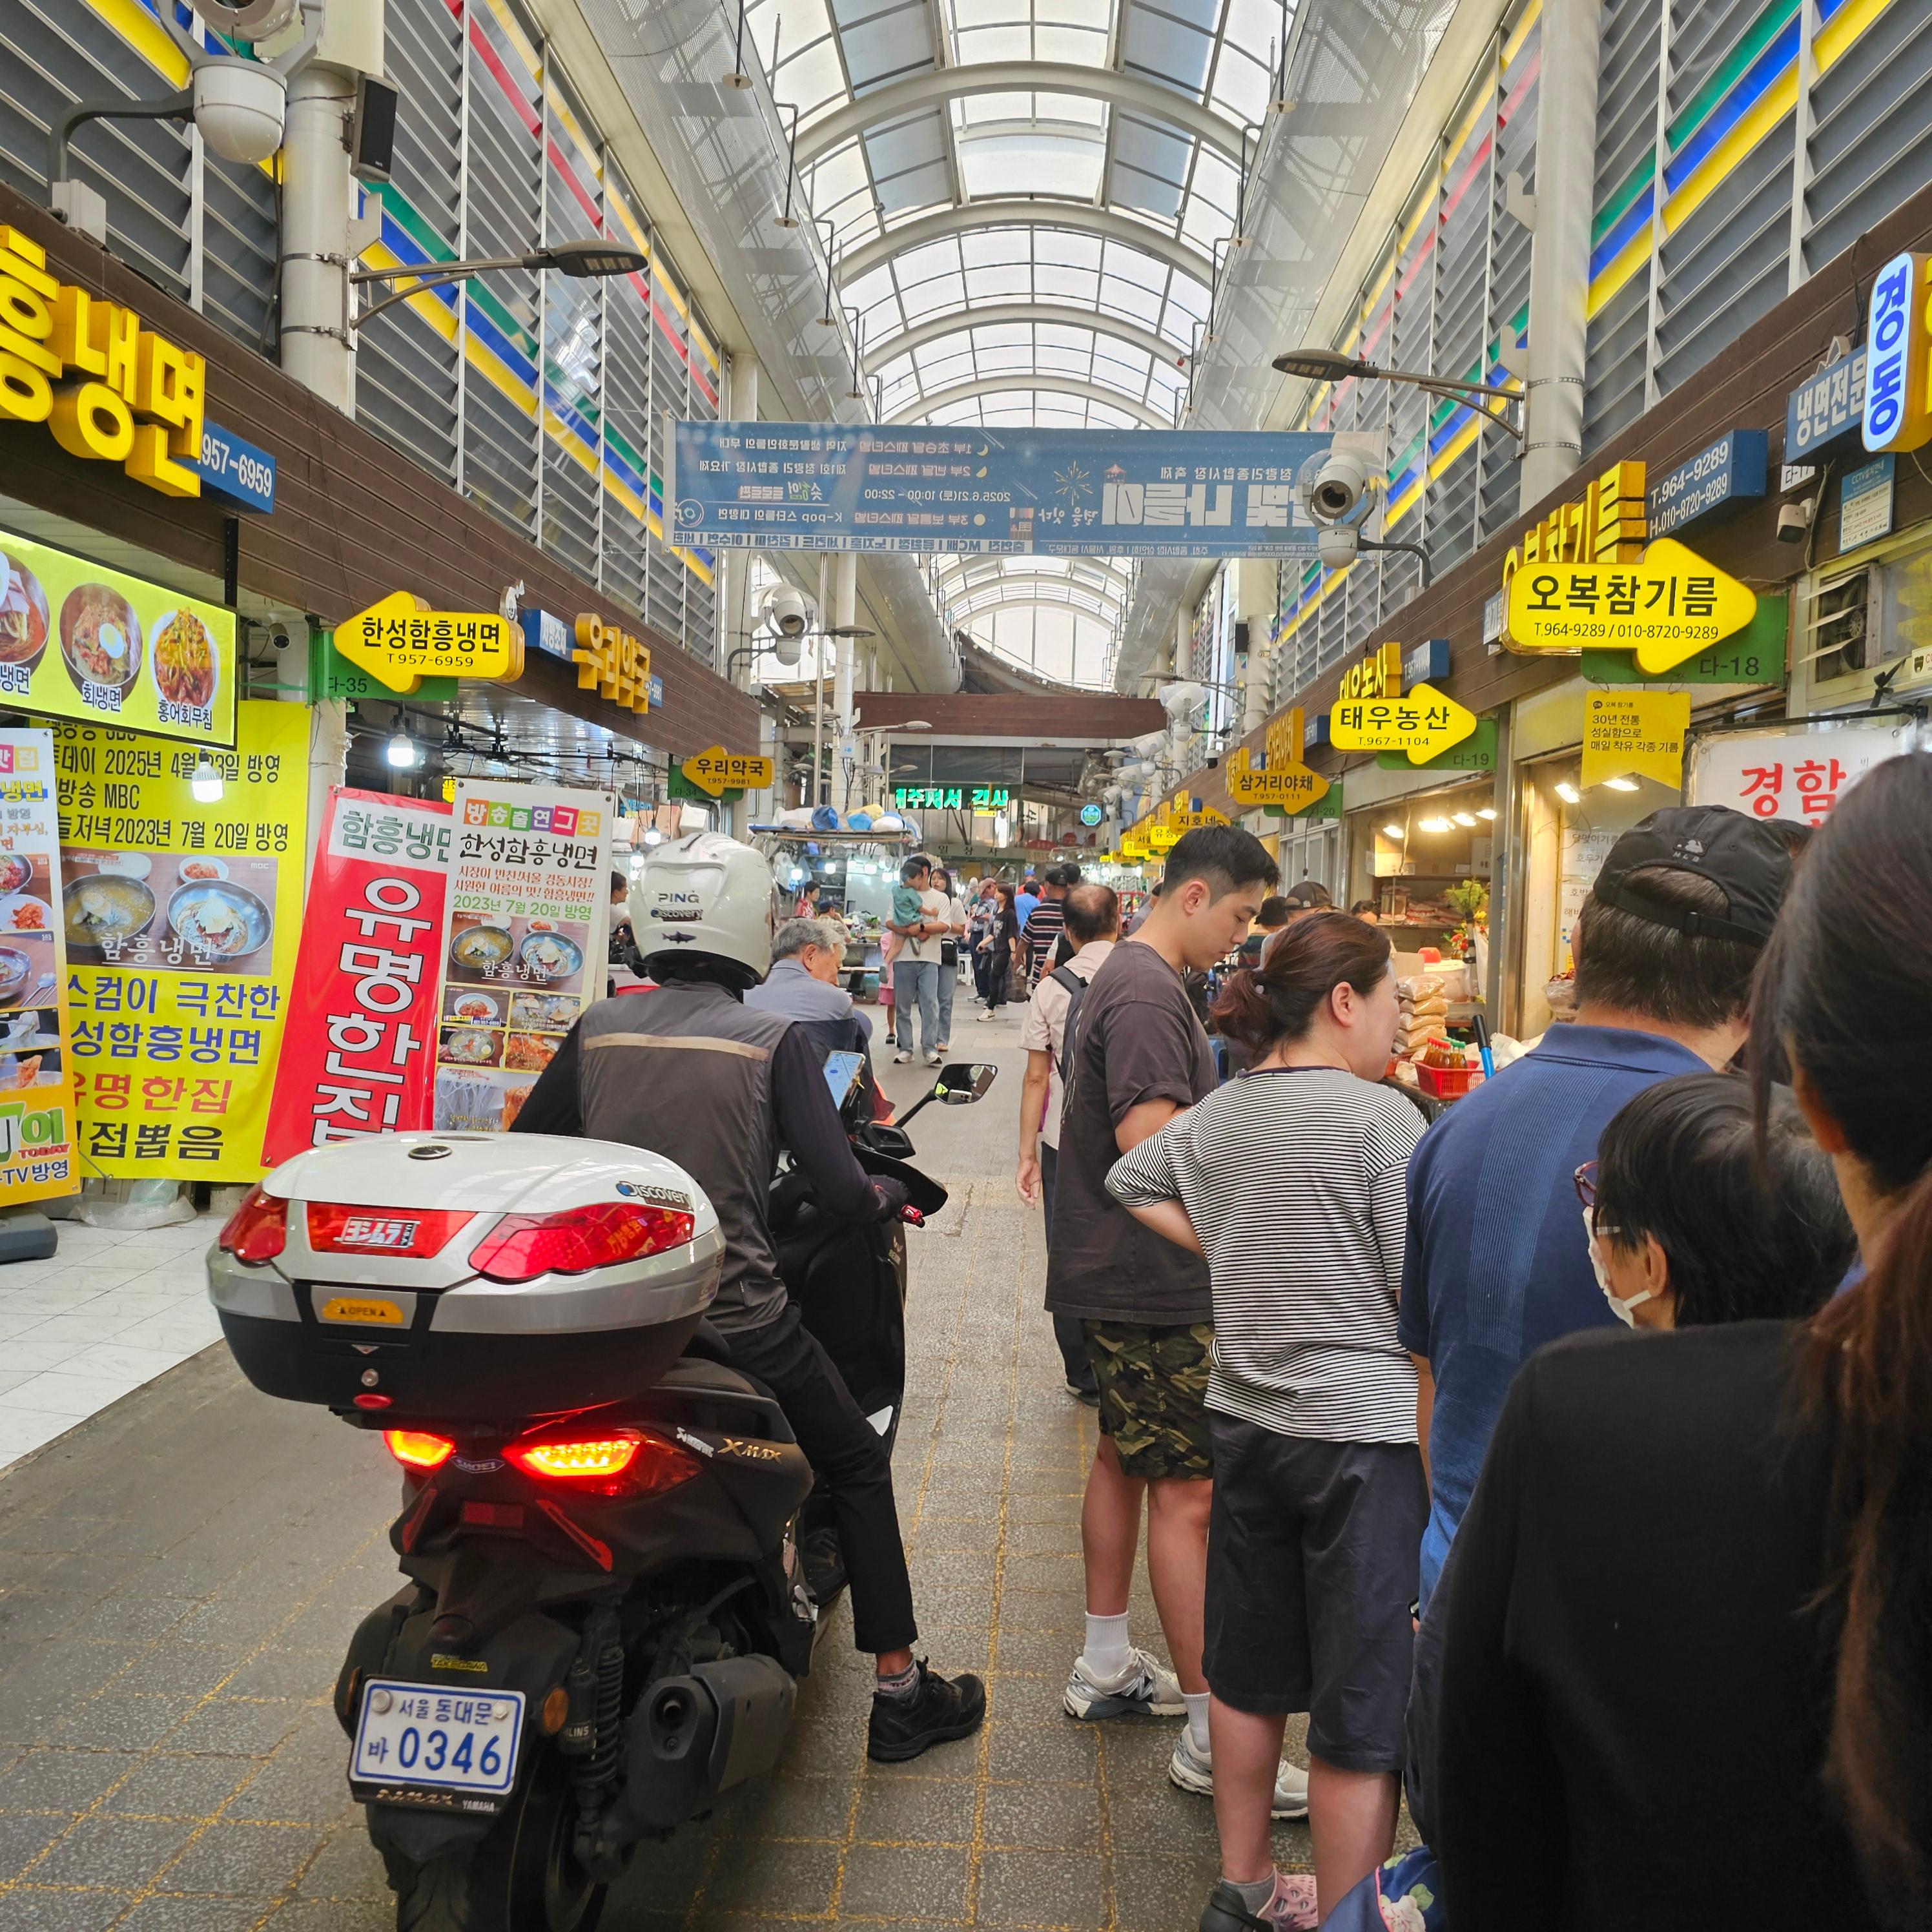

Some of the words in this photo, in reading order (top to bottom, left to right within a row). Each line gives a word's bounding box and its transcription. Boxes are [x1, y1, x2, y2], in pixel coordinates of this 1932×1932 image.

[1869, 263, 1908, 436] 경동
[1797, 353, 1866, 446] 냉면전문
[1651, 441, 1728, 509] T.964-9289
[1649, 473, 1727, 539] H.010-8720-9289
[1526, 574, 1718, 617] 오복참기름
[362, 616, 500, 653] 한성함흥냉면
[1534, 622, 1605, 637] T.964-9289
[1618, 624, 1718, 639] 010-8720-9289
[1699, 656, 1759, 677] 다-18
[83, 683, 121, 712] 회냉면
[158, 699, 212, 731] 홍어회무침
[1341, 706, 1450, 730] 태우농산
[1592, 715, 1617, 724] 30년
[1620, 715, 1640, 725] 전통
[1357, 737, 1430, 746] T.967-1104
[1591, 728, 1642, 738] 성실함으로
[1454, 753, 1489, 766] 다-19
[1590, 741, 1610, 751] 매일
[1613, 741, 1634, 752] 착유
[1636, 741, 1656, 752] 각종
[1659, 742, 1679, 753] 기름
[105, 749, 161, 778] 2025년
[247, 754, 280, 783] 방영
[696, 759, 764, 777] 우리약국
[1240, 775, 1313, 791] 삼거리야채
[1740, 757, 1847, 817] 경함
[104, 785, 140, 810] MBC
[181, 821, 205, 849] 7월
[214, 823, 249, 850] 20일
[256, 823, 289, 852] 방영
[460, 833, 597, 870] 한성함흥냉면
[453, 895, 501, 912] 2023년
[505, 899, 526, 914] 7월
[530, 901, 560, 918] 20일
[564, 904, 592, 921] 방영
[658, 890, 700, 903] PING
[650, 908, 703, 921] Discovery
[99, 933, 216, 966] 함흥냉면
[482, 960, 548, 981] 함흥냉면
[176, 981, 281, 1020] 극찬한
[70, 1021, 261, 1065] 성함흥냉면
[18, 1143, 71, 1159] TODAY
[32, 1159, 69, 1182] 방영
[617, 1181, 694, 1208] Discovery
[349, 1307, 376, 1316] OPEN
[717, 1437, 782, 1464] XMAX
[398, 1698, 429, 1720] 서울
[435, 1698, 492, 1725] 동대문
[368, 1736, 389, 1765] 바
[398, 1727, 500, 1776] 0346
[376, 1789, 453, 1805] NMAX
[462, 1800, 495, 1813] YAMAHA
